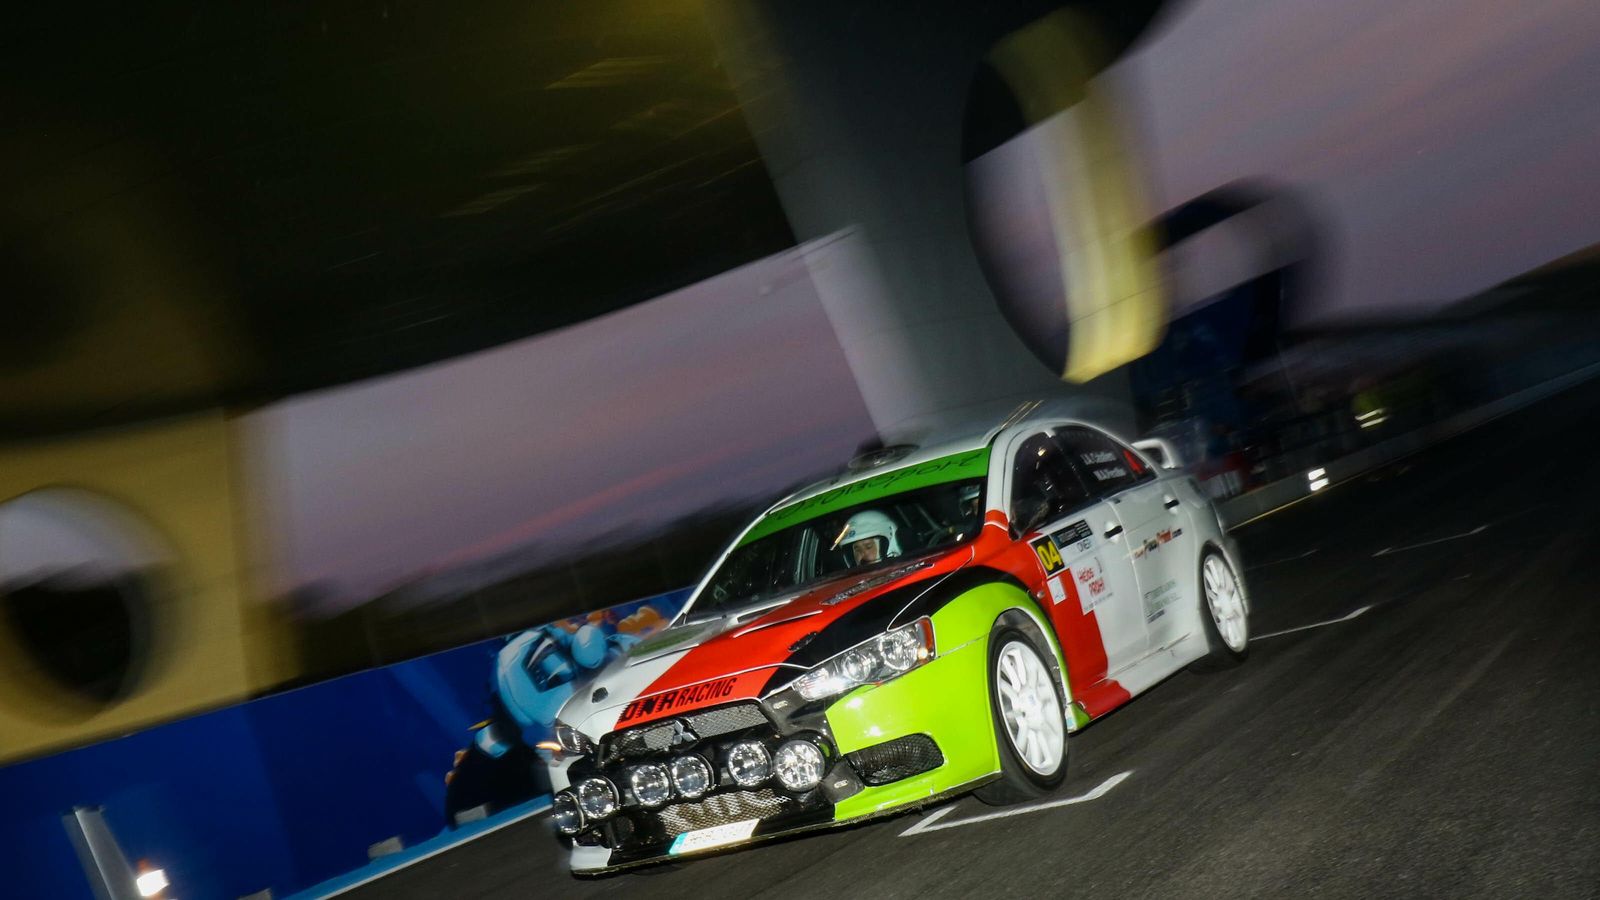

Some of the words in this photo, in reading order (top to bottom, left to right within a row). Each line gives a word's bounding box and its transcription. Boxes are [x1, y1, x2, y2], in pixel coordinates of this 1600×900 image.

[1037, 541, 1063, 571] 04
[618, 690, 680, 723] DNA
[674, 678, 738, 707] RACING
